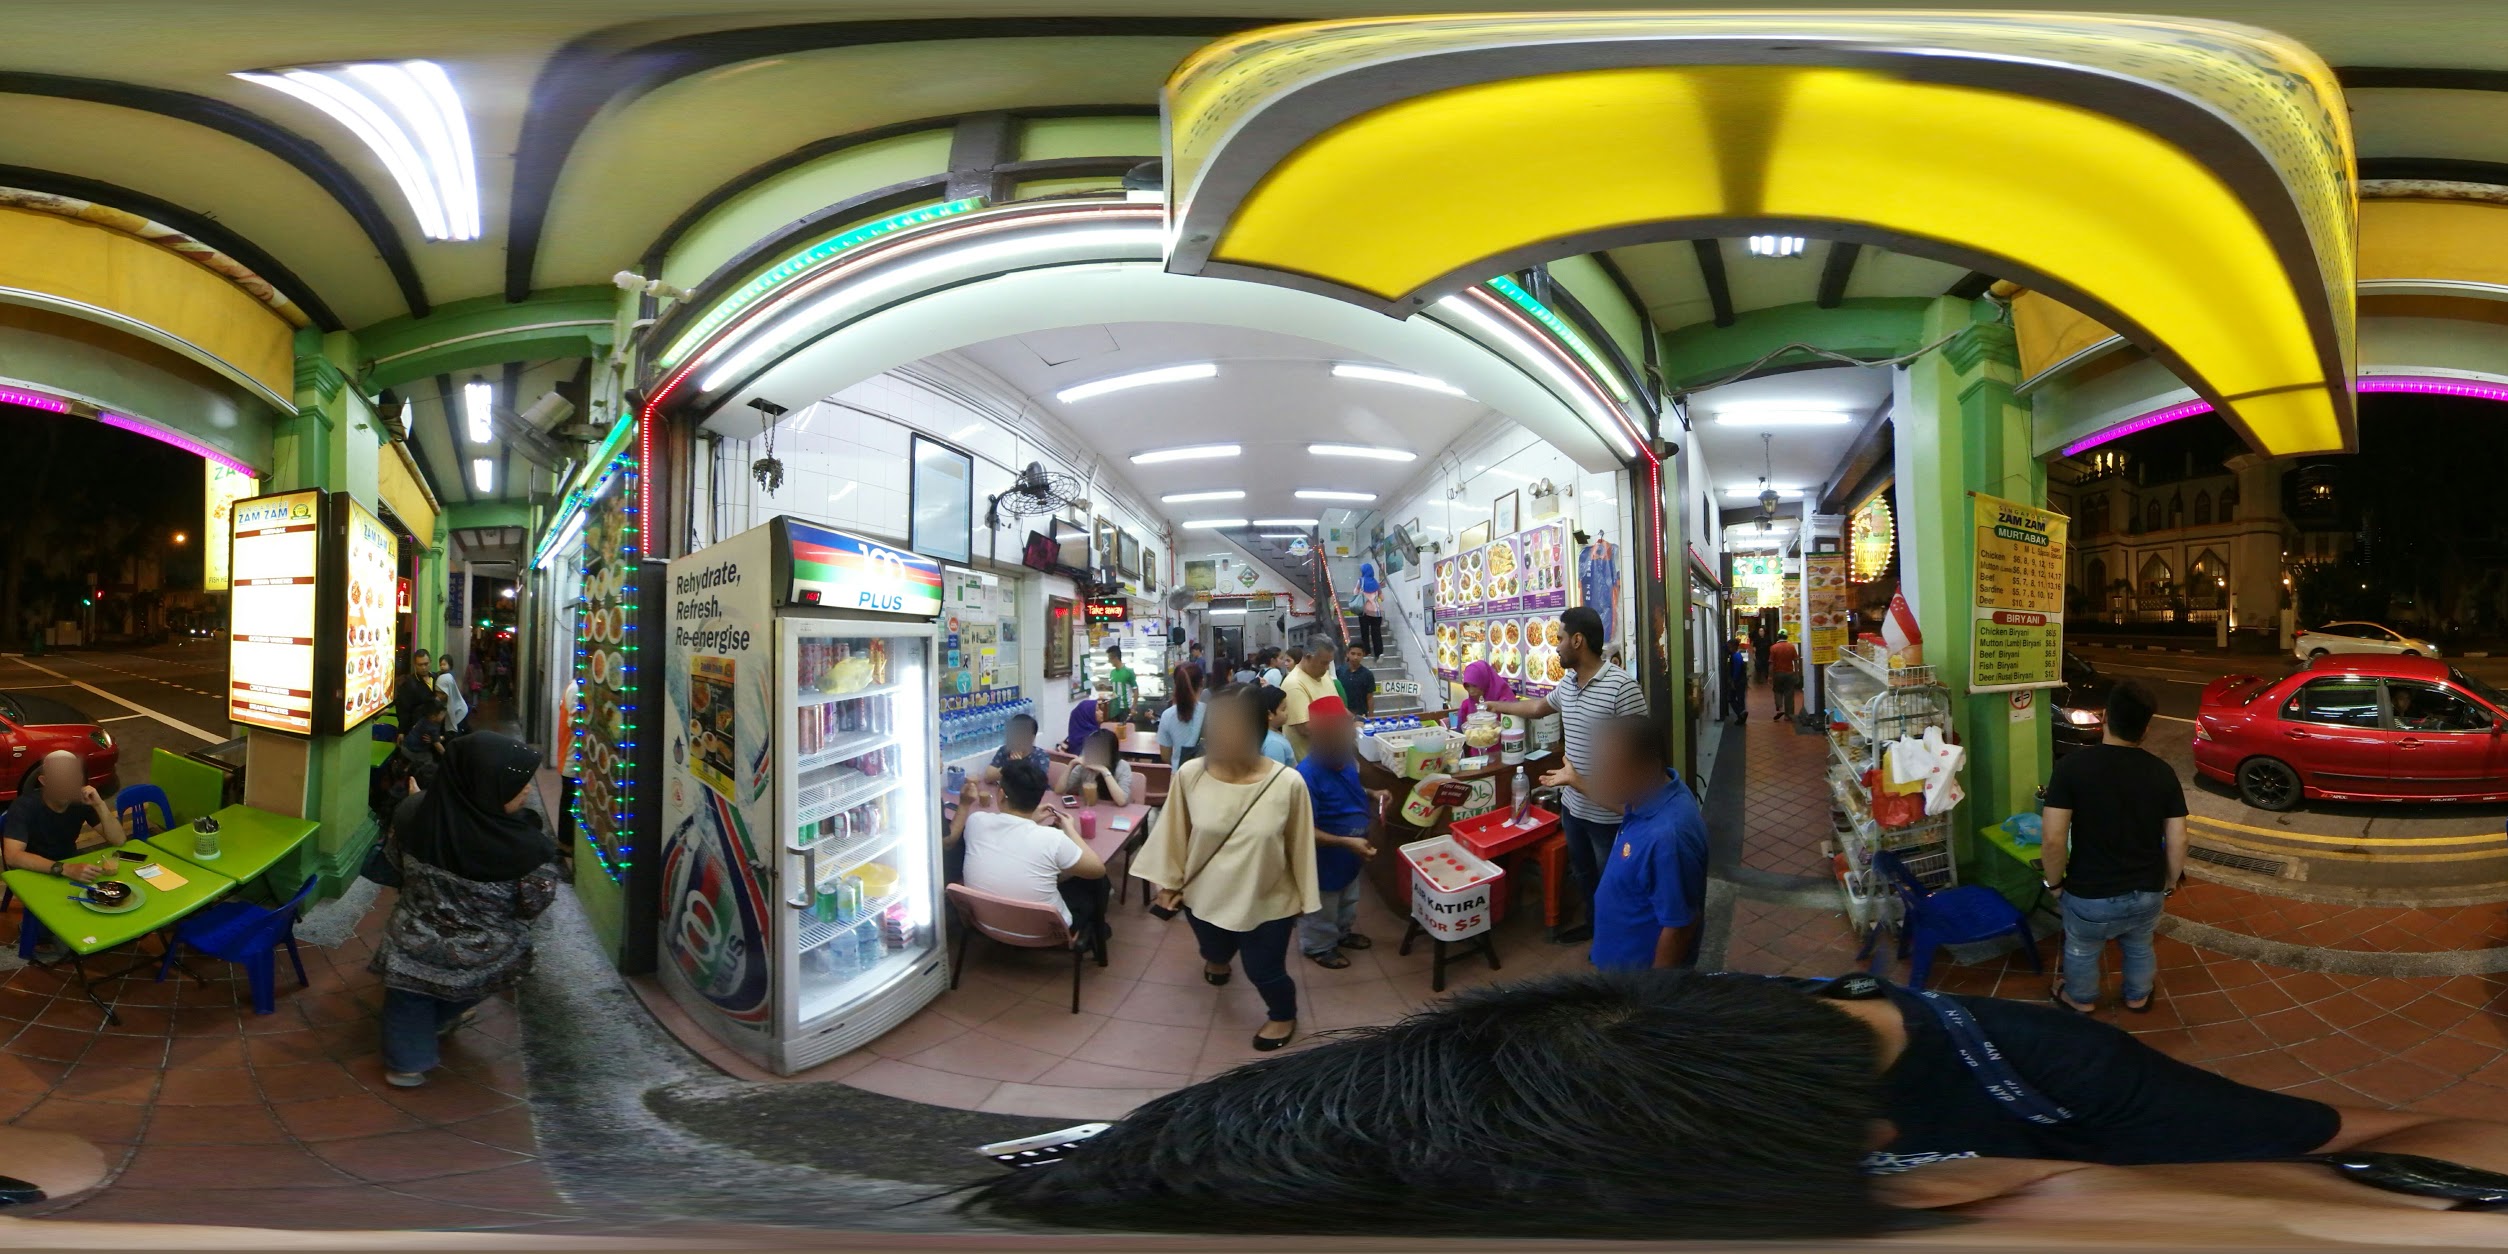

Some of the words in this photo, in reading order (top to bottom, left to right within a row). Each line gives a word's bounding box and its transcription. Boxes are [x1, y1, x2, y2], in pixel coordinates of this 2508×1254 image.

[238, 511, 260, 523] ZAM
[264, 507, 288, 519] ZAM
[1999, 505, 2046, 521] SINGAPORE
[1998, 512, 2022, 526] ZAM
[2024, 518, 2046, 532] ZAM
[1998, 527, 2047, 545] MURTABAK
[1980, 549, 2006, 560] Chicken
[2024, 545, 2029, 553] M
[1980, 561, 2000, 571] Mutton
[208, 576, 220, 584] FISH
[676, 561, 741, 596] Rehydrate,
[1980, 572, 1995, 581] Beef
[1979, 584, 2004, 594] Sardine
[858, 591, 903, 610] PLUS
[1979, 596, 1995, 604] Deer
[2028, 600, 2035, 608] 20
[676, 594, 722, 622] Refresh,
[1087, 605, 1104, 615] Take
[1104, 605, 1123, 617] away
[2006, 614, 2040, 624] BIRYANI
[675, 624, 750, 654] Re-energise
[1980, 627, 2007, 636] Chicken
[2008, 628, 2029, 637] Biryani
[2045, 629, 2057, 637] $6.5
[1979, 638, 2003, 647] Mutton
[2022, 640, 2042, 648] Biryani
[1979, 650, 1995, 658] Beef
[1998, 650, 2020, 660] Biryani
[1979, 661, 1994, 669] Fish
[1997, 661, 2019, 671] Biryani
[1979, 673, 1995, 681] Deer
[2013, 671, 2034, 680] Biryani
[2045, 670, 2054, 678] $12
[1385, 681, 1418, 695] CASHIER
[1420, 757, 1443, 771] F&N
[1408, 801, 1433, 818] F&N
[1427, 895, 1486, 914] KATIRA
[1455, 914, 1481, 931] $5
[1984, 1042, 2002, 1060] NYP
[1959, 1050, 1979, 1067] NYP
[1986, 1085, 2016, 1101] NYP
